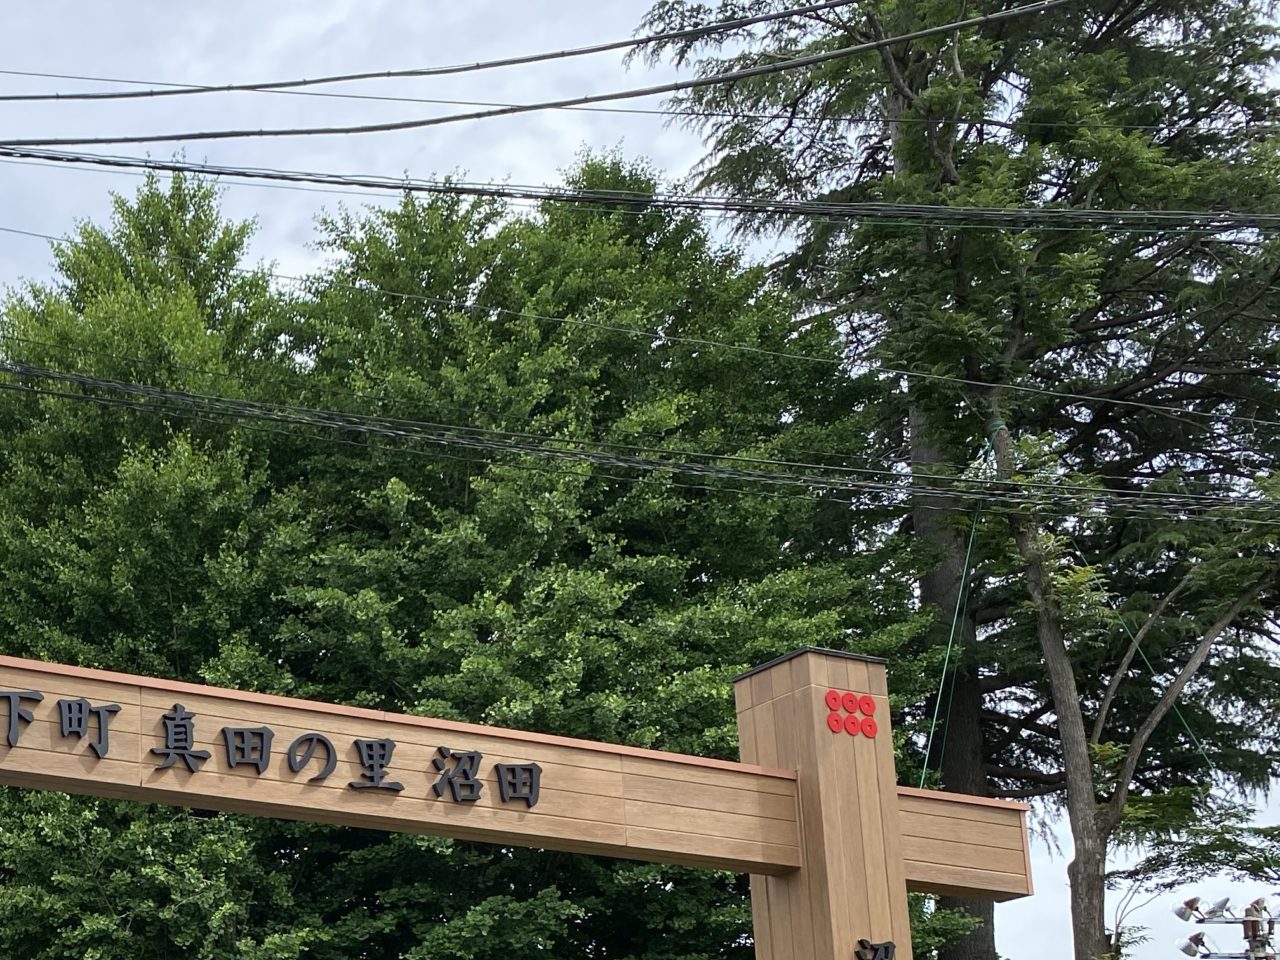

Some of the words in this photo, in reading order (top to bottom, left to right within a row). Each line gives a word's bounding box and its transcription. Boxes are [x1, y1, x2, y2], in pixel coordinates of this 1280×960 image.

[150, 702, 405, 793] 真田の里
[432, 746, 543, 809] 沼田
